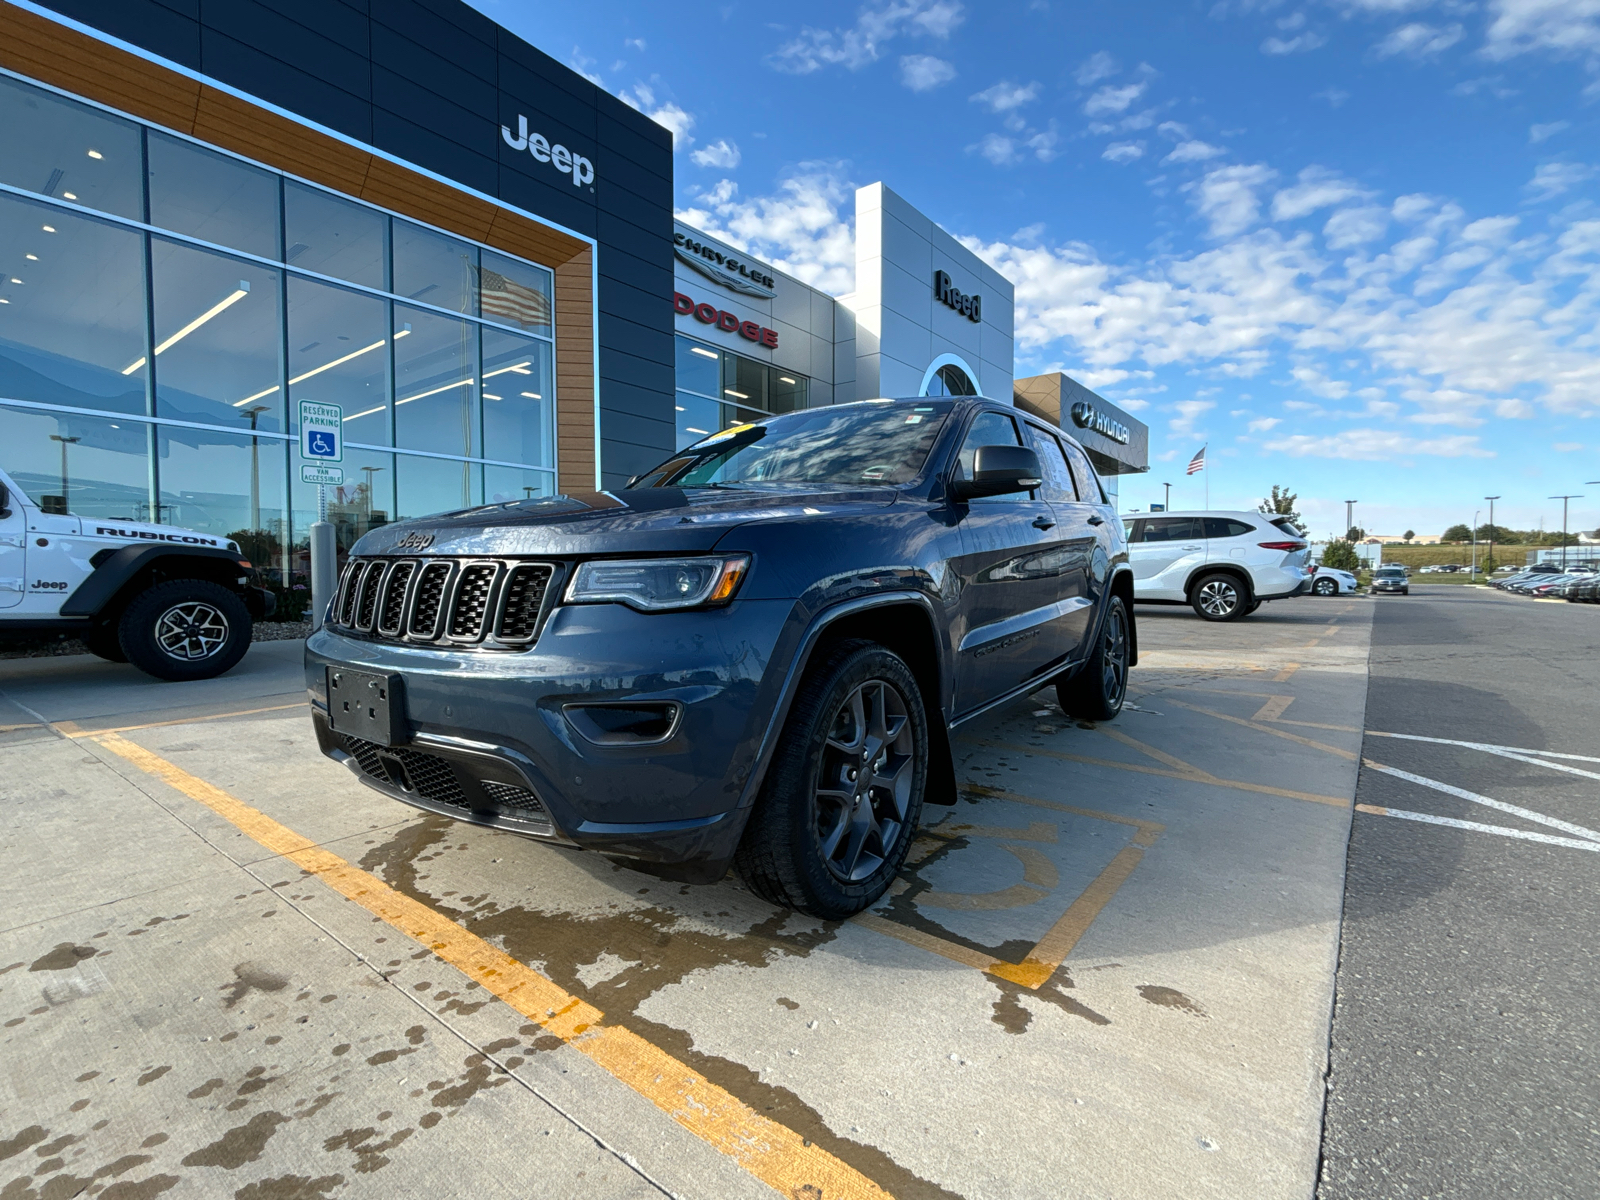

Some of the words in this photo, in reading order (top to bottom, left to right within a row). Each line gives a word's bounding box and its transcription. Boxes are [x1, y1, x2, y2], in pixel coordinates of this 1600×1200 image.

[501, 114, 595, 187] Jeep
[674, 233, 775, 288] CHRYSLER
[935, 269, 981, 323] Reed
[674, 291, 779, 349] DODGE
[303, 405, 339, 418] RESERVED
[303, 416, 339, 428] PARKING
[1096, 411, 1130, 445] HYUNDAI
[304, 474, 342, 483] ACCESSIBLE
[316, 468, 329, 476] VAN
[96, 526, 217, 547] RUBICON
[397, 531, 435, 552] Jeep
[31, 579, 69, 591] Jeep
